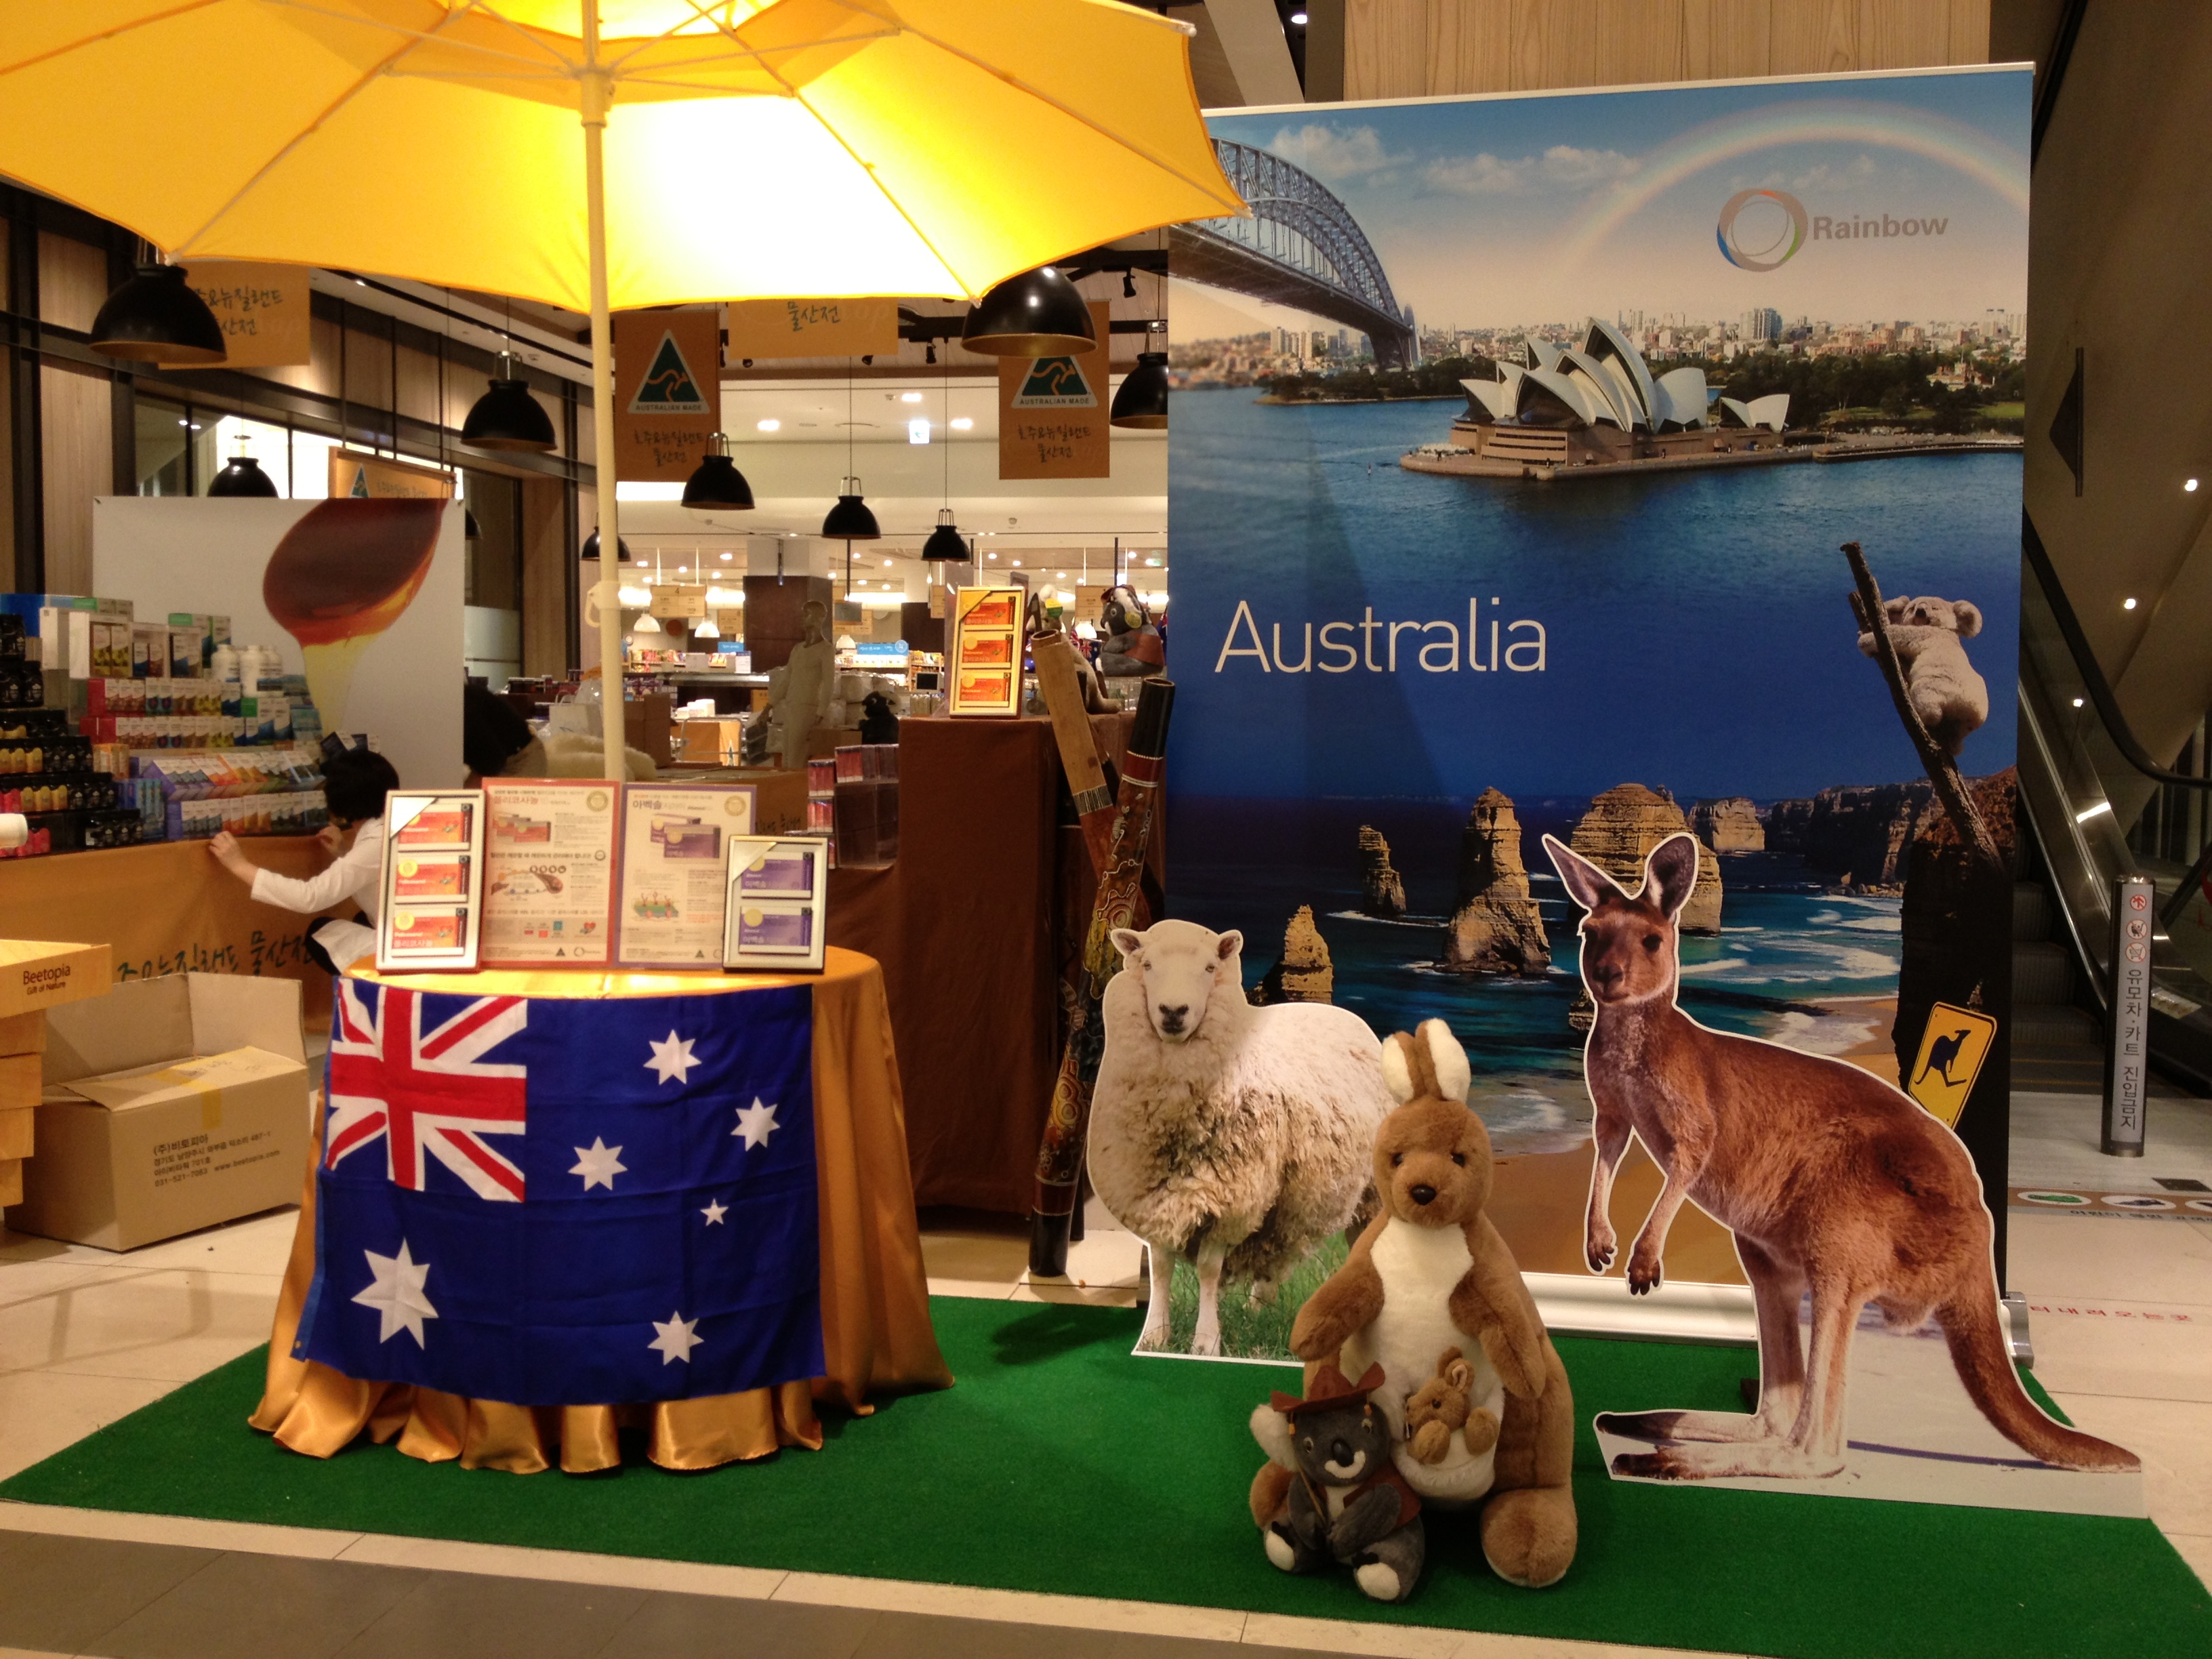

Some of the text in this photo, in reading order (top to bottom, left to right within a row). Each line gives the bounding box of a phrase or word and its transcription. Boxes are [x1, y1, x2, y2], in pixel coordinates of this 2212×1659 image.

[1812, 213, 1949, 240] Rainbow
[216, 317, 257, 335] 산전
[787, 301, 841, 332] 물산전
[1214, 596, 1547, 674] Australia
[23, 963, 70, 985] Beetopia
[2120, 1065, 2139, 1130] 진입금지
